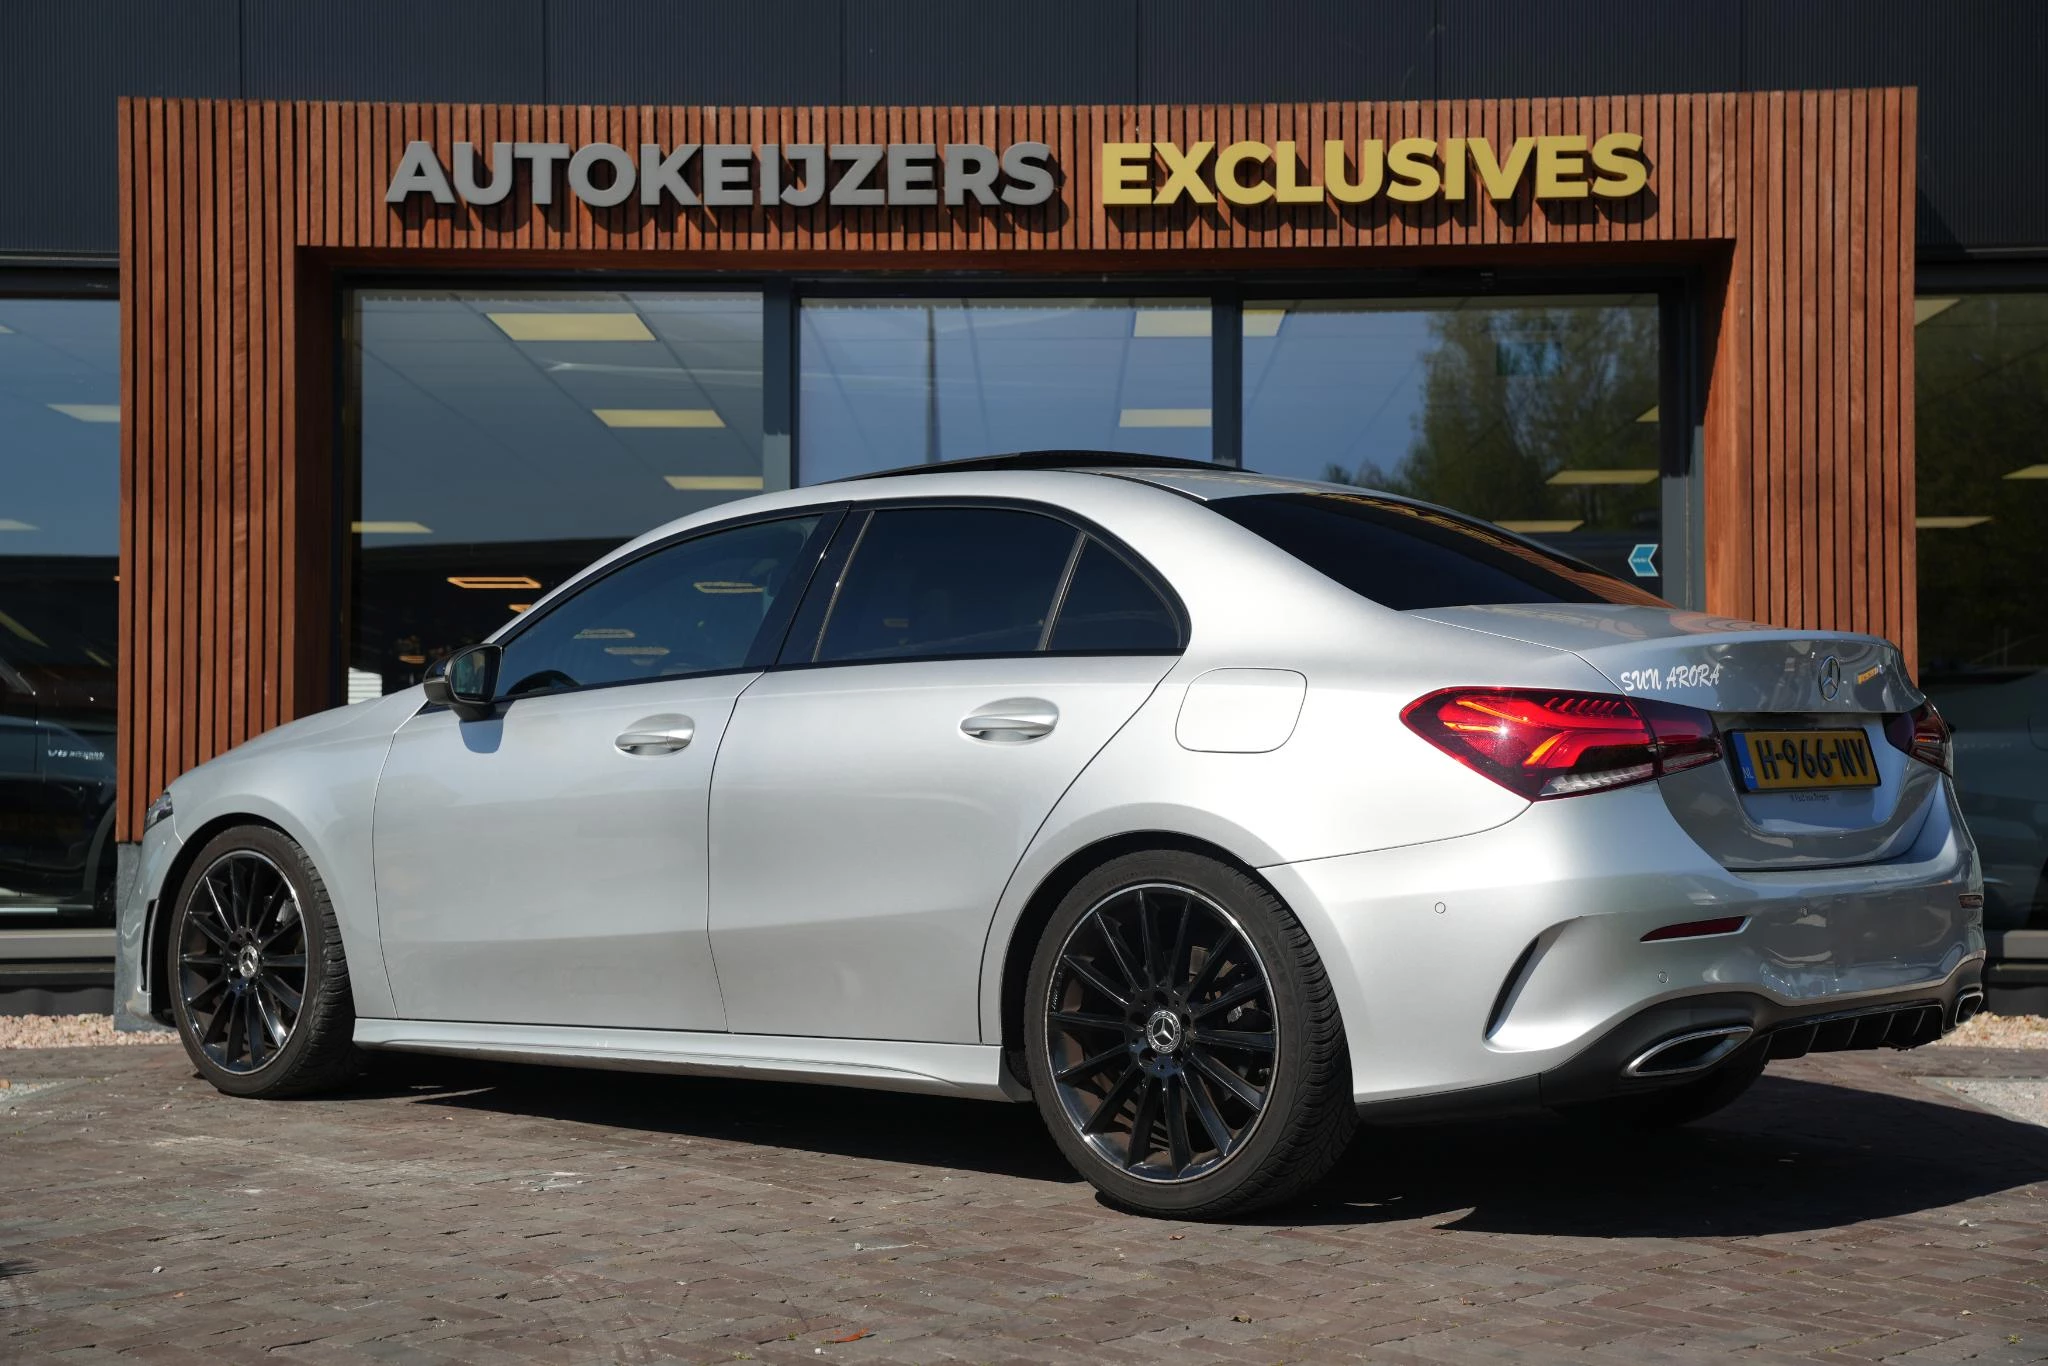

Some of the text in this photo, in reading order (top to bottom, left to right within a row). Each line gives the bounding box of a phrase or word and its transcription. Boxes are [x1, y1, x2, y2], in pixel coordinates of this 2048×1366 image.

[386, 132, 1648, 208] AUTOKEIJZERS EXCLUSIVES
[1620, 663, 1721, 692] SUN ARORA
[1755, 738, 1869, 780] H-966-NV
